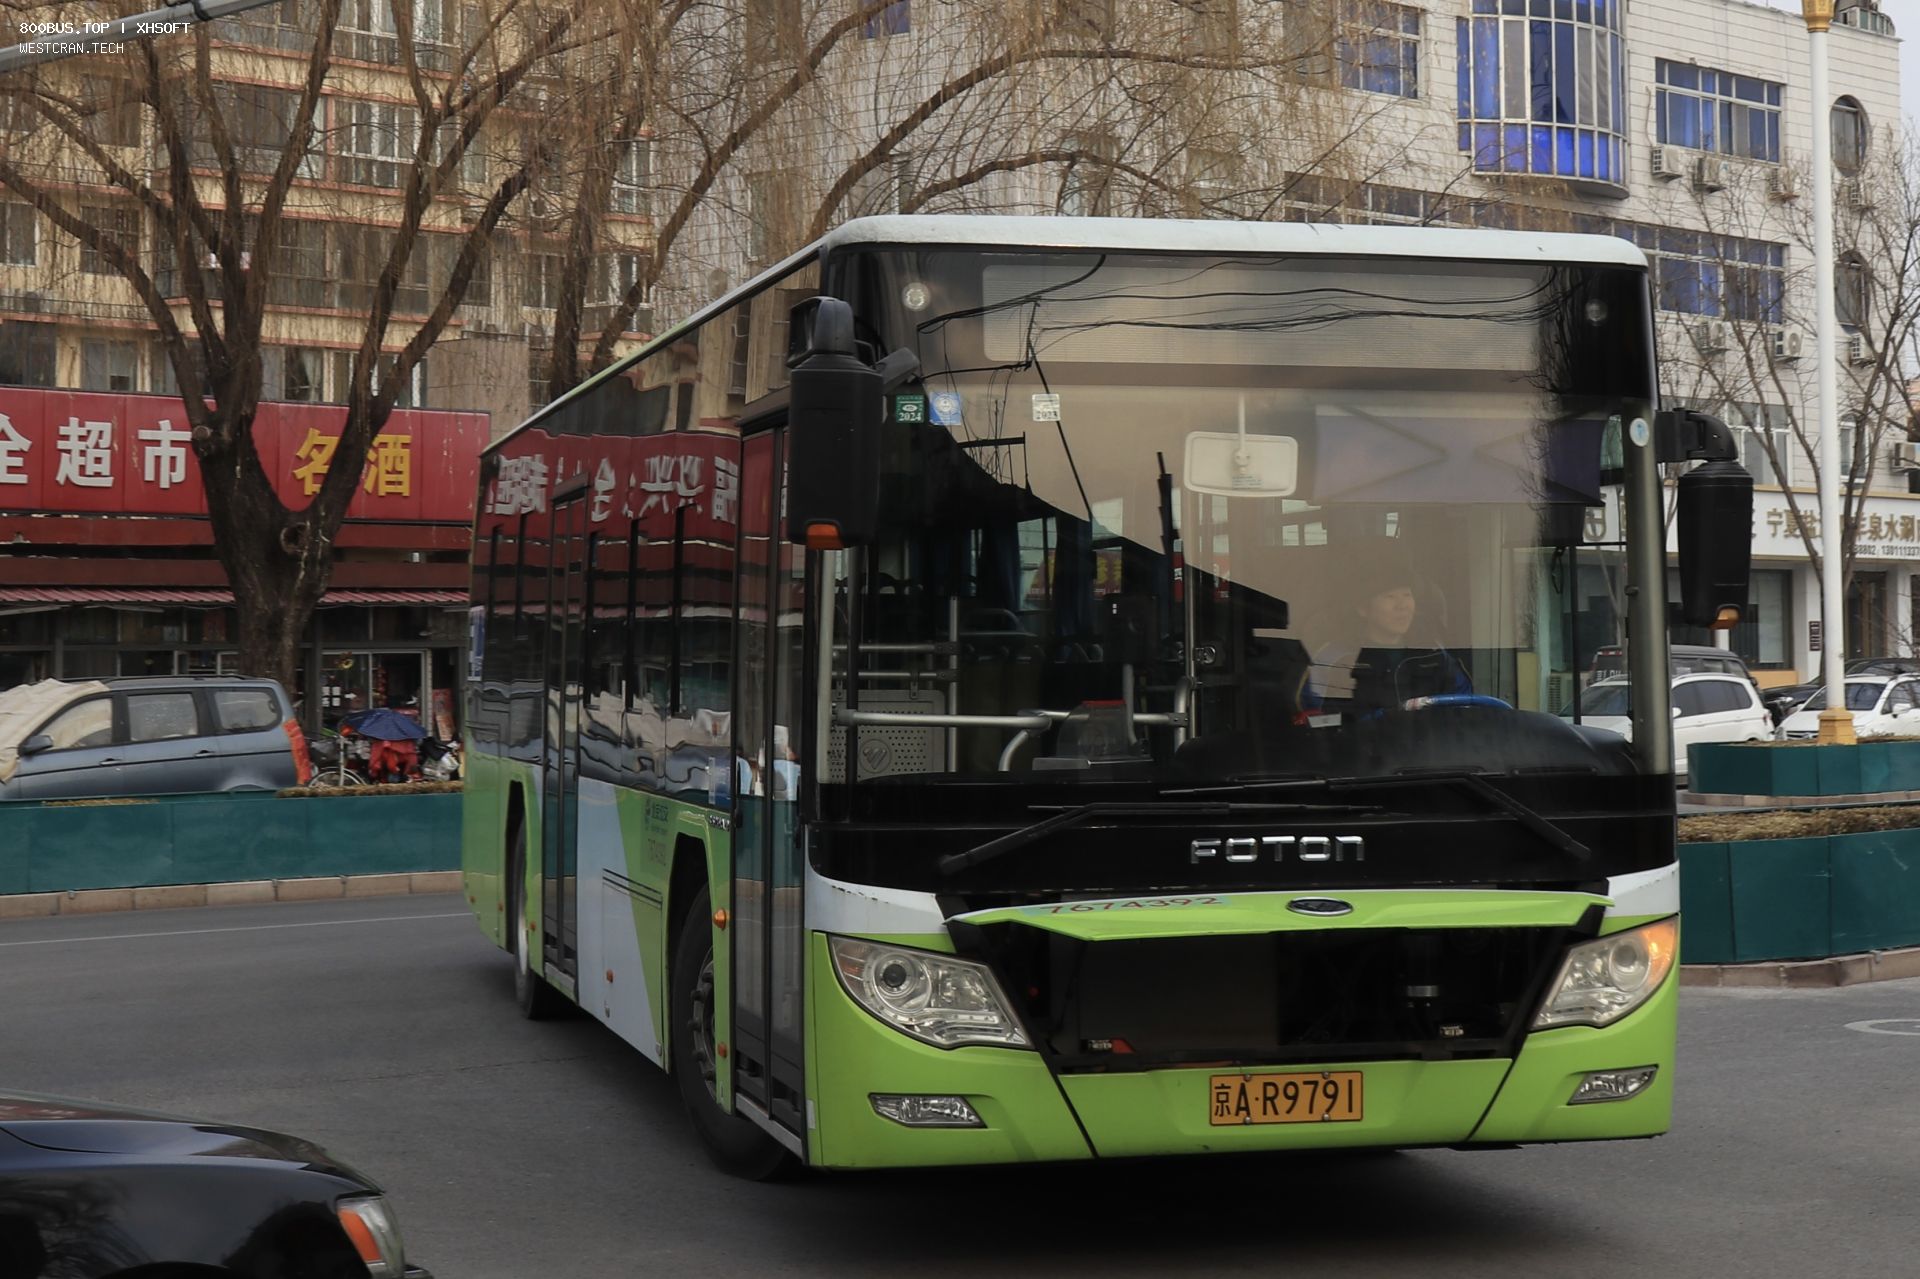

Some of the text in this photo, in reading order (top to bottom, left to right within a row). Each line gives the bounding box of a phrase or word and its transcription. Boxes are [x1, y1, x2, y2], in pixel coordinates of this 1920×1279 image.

[898, 412, 922, 422] 2024
[292, 428, 411, 497] 名酒
[1191, 836, 1364, 864] FOTON
[1214, 1079, 1353, 1117] 京A·R9791
